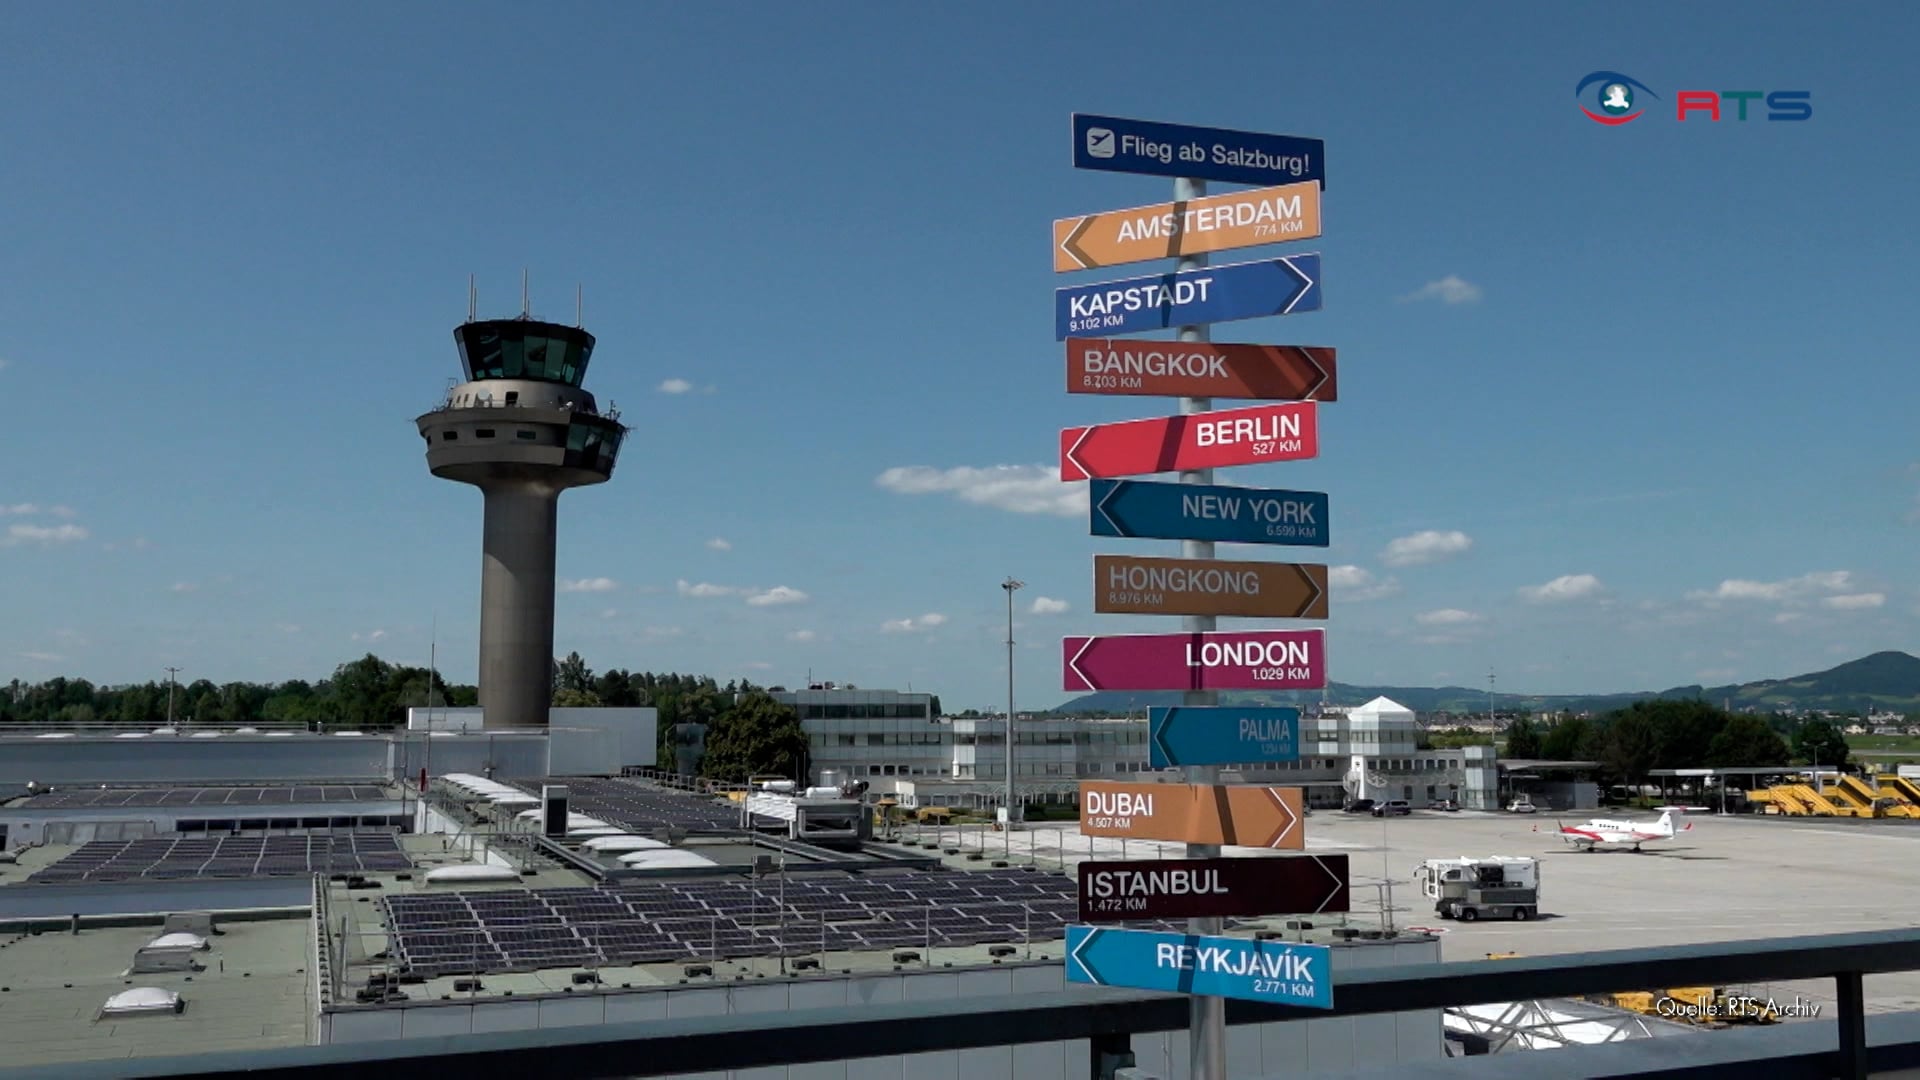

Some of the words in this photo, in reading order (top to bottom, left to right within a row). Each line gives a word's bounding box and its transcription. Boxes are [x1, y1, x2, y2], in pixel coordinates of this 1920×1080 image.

[1121, 135, 1173, 163] Flieg
[1178, 142, 1206, 162] ab
[1211, 144, 1311, 176] Salzburg!
[1117, 195, 1302, 244] AMSTERDAM
[1254, 222, 1277, 237] 774
[1280, 220, 1303, 234] KM
[1070, 278, 1213, 318] KAPSTADT
[1069, 317, 1100, 332] 9.102
[1103, 314, 1124, 328] KM
[1084, 350, 1229, 379] BANGKOK
[1083, 375, 1117, 388] 8.703
[1120, 376, 1142, 388] KM
[1196, 413, 1300, 447] BERLIN
[1252, 441, 1275, 455] 527
[1279, 439, 1301, 453] KM
[1182, 494, 1241, 520] NEW
[1248, 499, 1316, 524] YORK
[1298, 526, 1316, 538] KM
[1109, 565, 1260, 595] HONGKONG
[1109, 592, 1141, 605] 8.976
[1143, 593, 1164, 606] KM
[1185, 640, 1309, 667] LONDON
[1252, 668, 1284, 681] 1.029
[1288, 667, 1310, 681] KM
[1239, 718, 1290, 742] PALMA
[1086, 791, 1153, 817] DUBAI
[1114, 818, 1131, 830] KM
[1087, 869, 1229, 898] ISTANBUL
[1087, 899, 1122, 912] 1.472
[1125, 898, 1147, 910] KM
[1157, 942, 1314, 983] REYKJAVÍK
[1254, 979, 1287, 994] 2.771
[1291, 982, 1315, 998] KM
